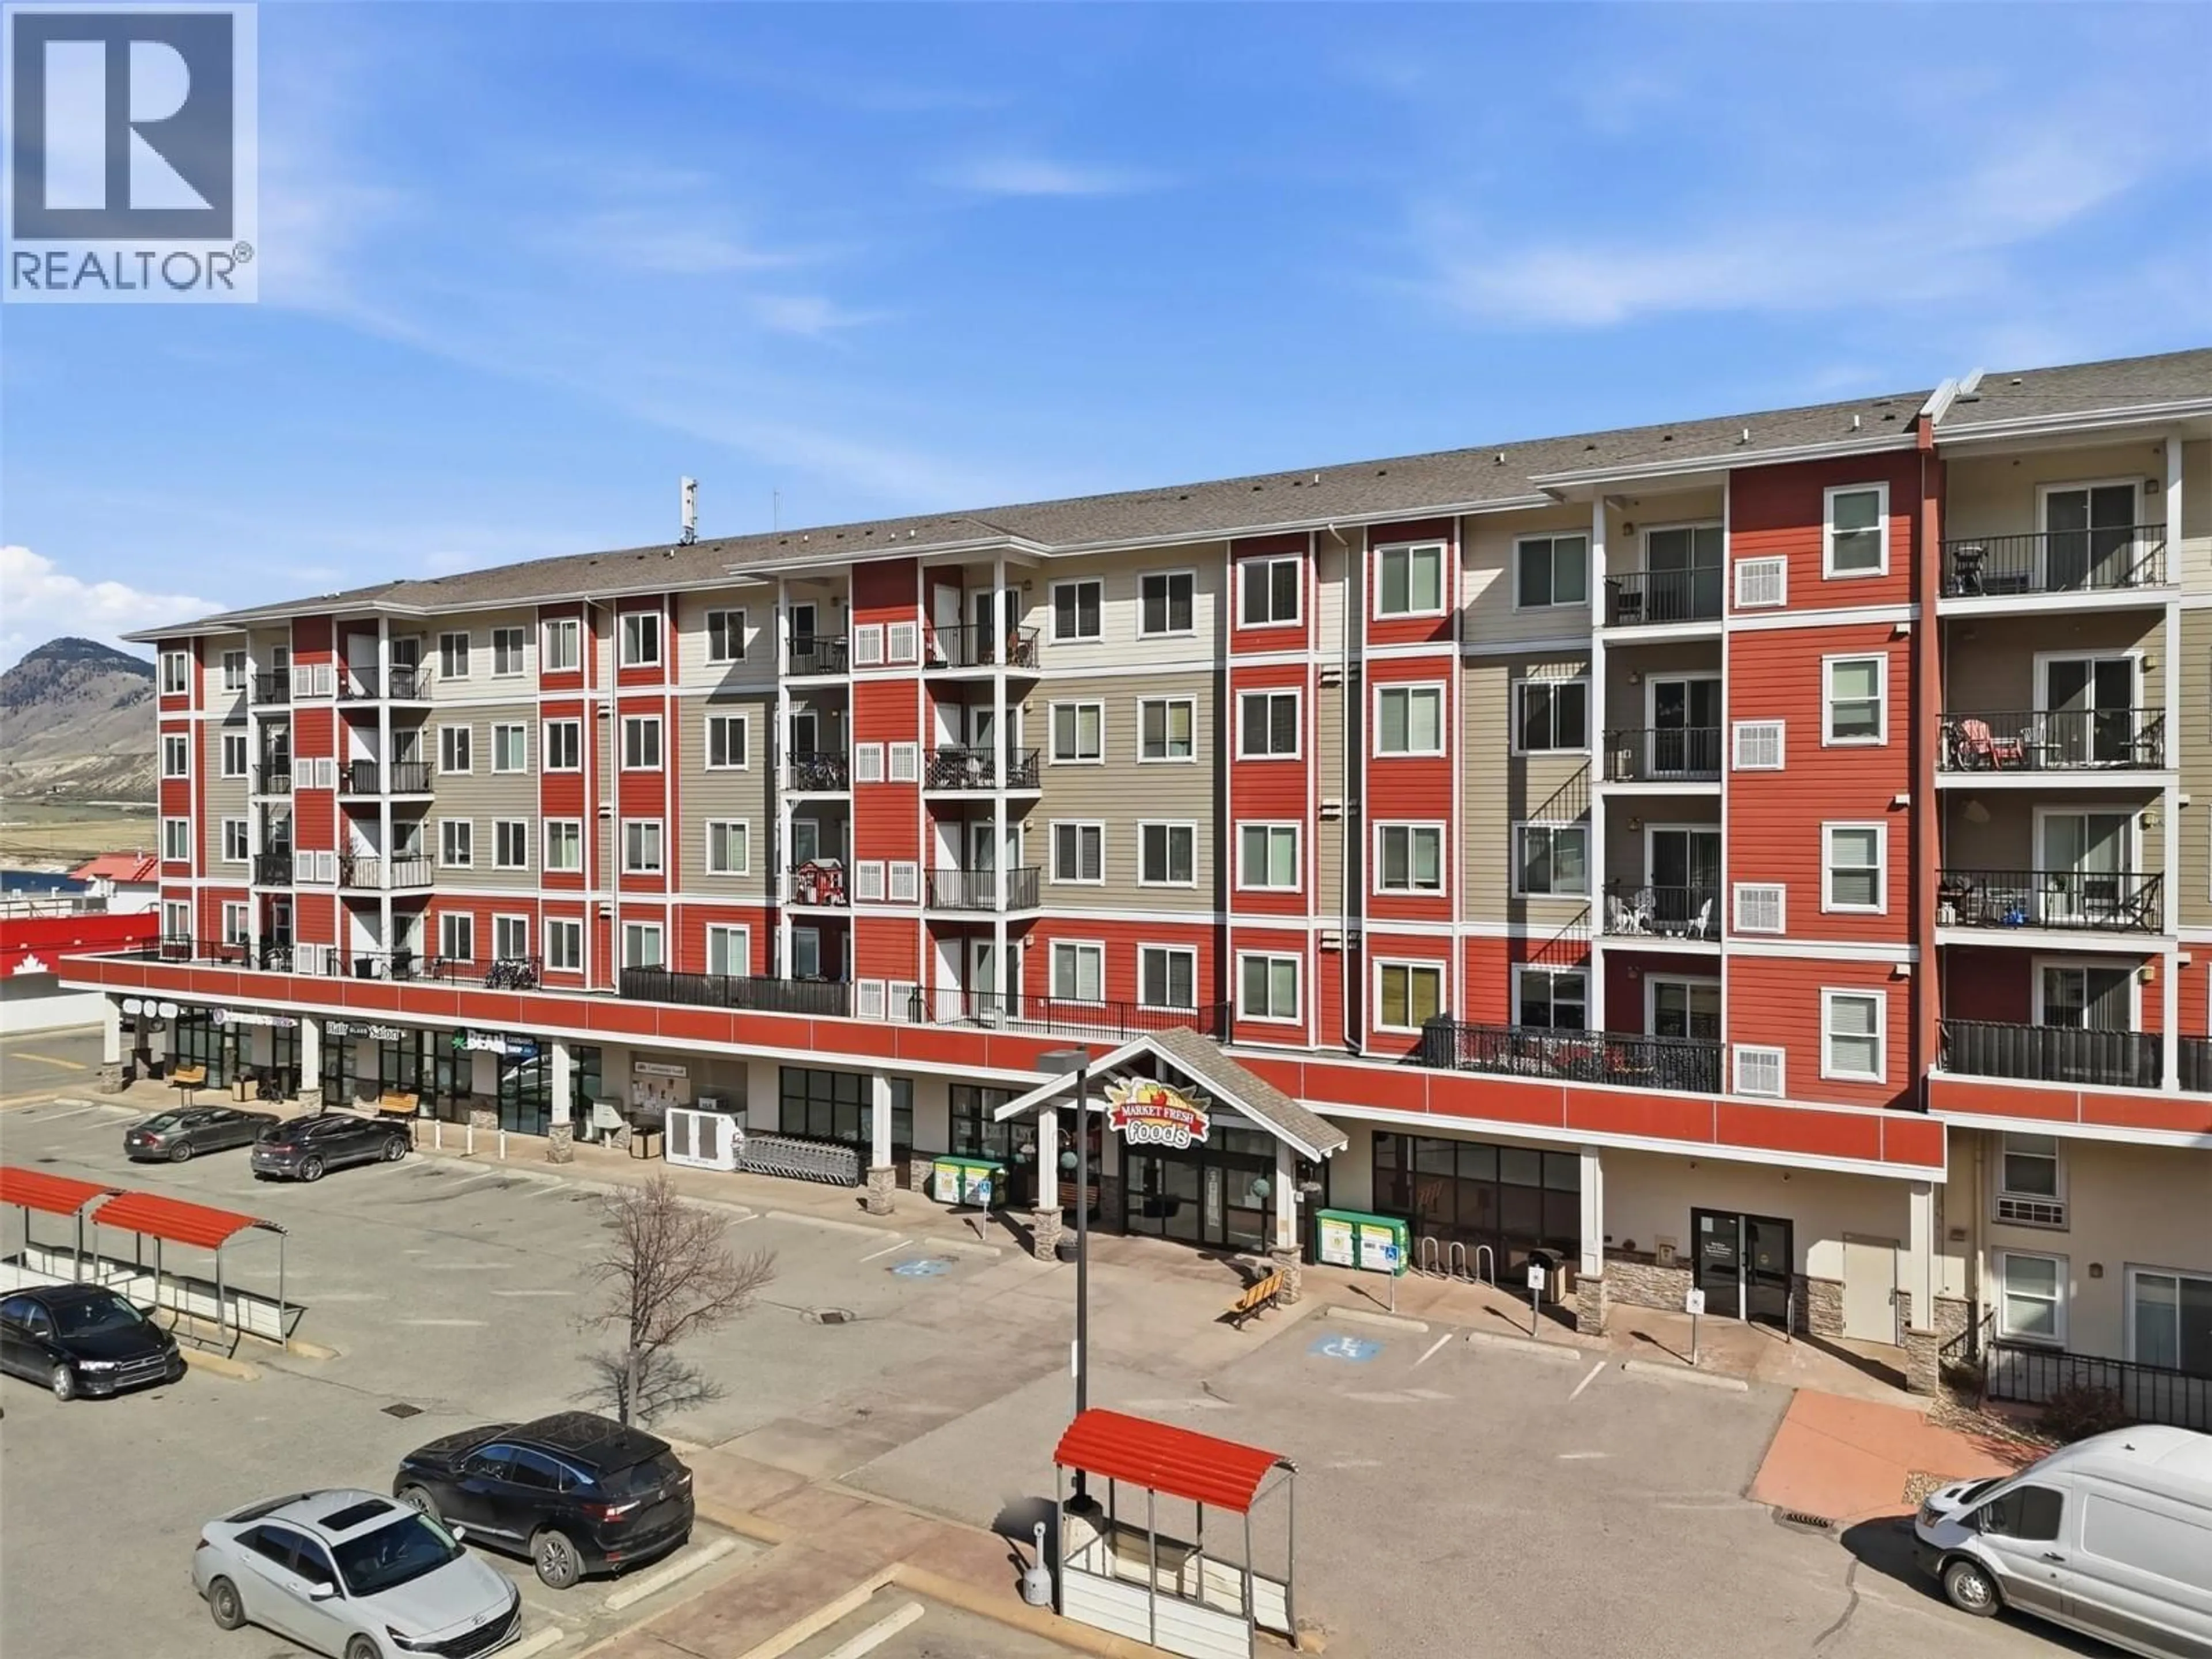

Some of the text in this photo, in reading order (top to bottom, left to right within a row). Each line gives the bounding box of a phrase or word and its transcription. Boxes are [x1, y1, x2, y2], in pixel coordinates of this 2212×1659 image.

[1121, 1104, 1194, 1124] MARKET FRESH
[1128, 1120, 1188, 1147] foods
